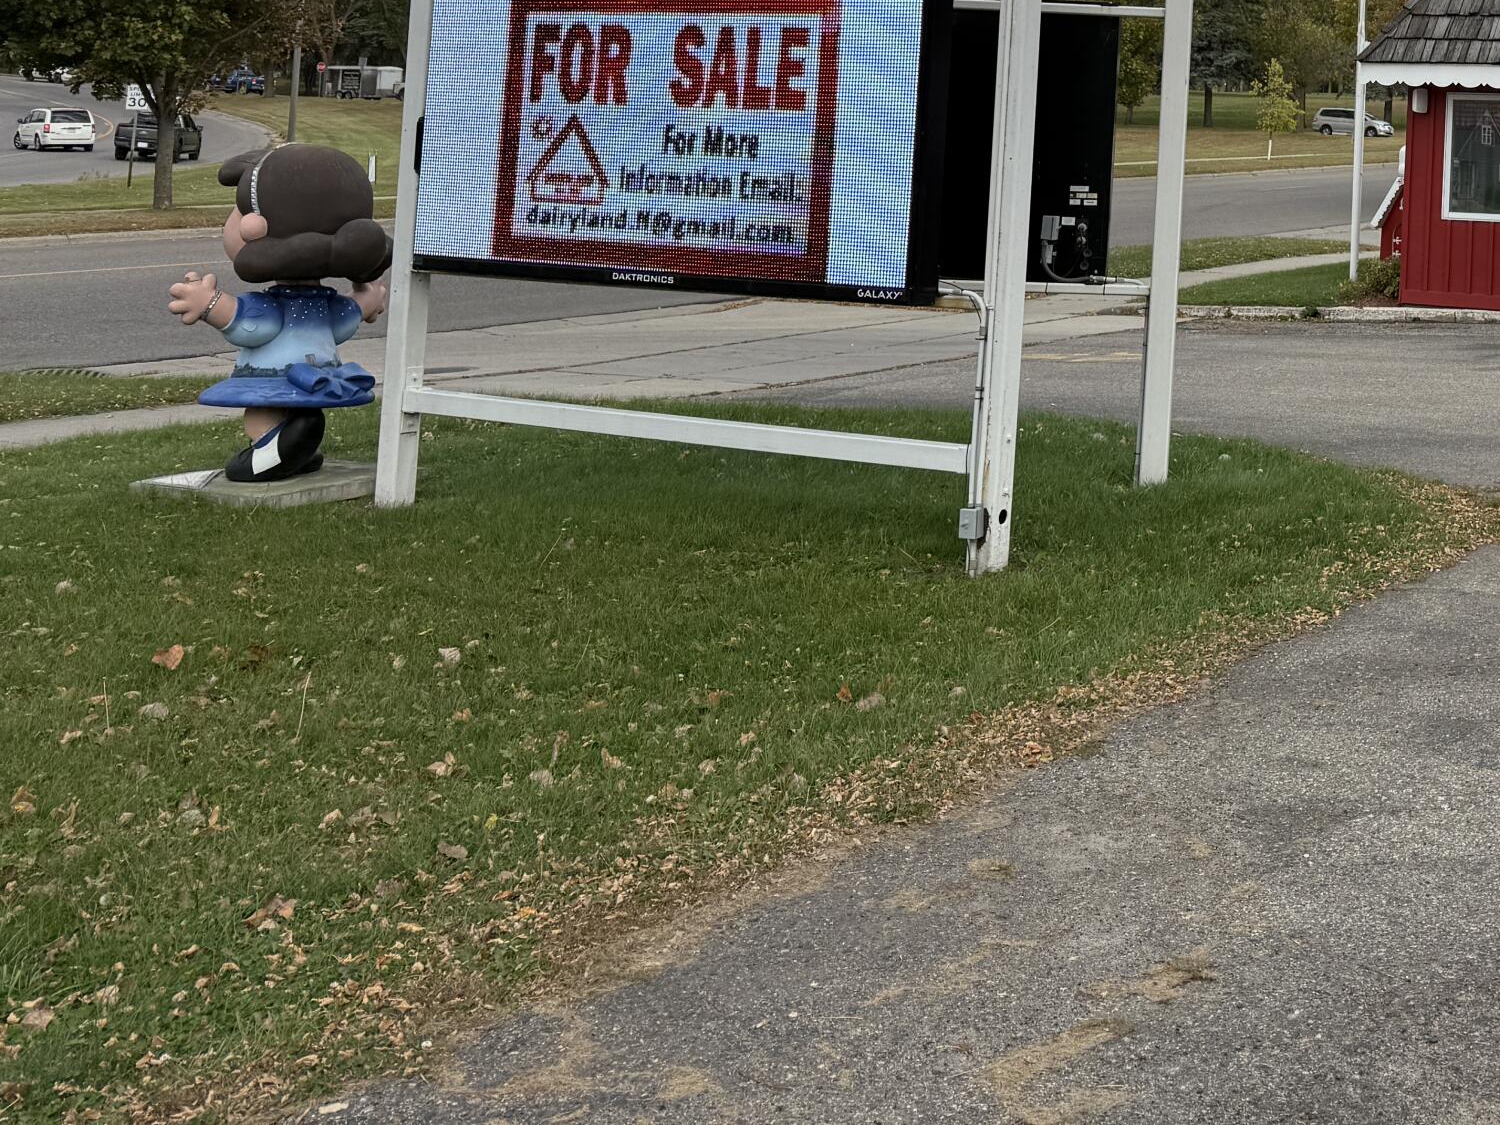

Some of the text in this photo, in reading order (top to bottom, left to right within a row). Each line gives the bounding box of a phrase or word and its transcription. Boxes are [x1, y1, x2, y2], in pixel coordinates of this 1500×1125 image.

[529, 23, 810, 111] FOR SALE
[127, 97, 147, 107] 30
[662, 124, 760, 159] For More
[619, 164, 733, 198] Information
[612, 272, 674, 284] DAKTRONICS
